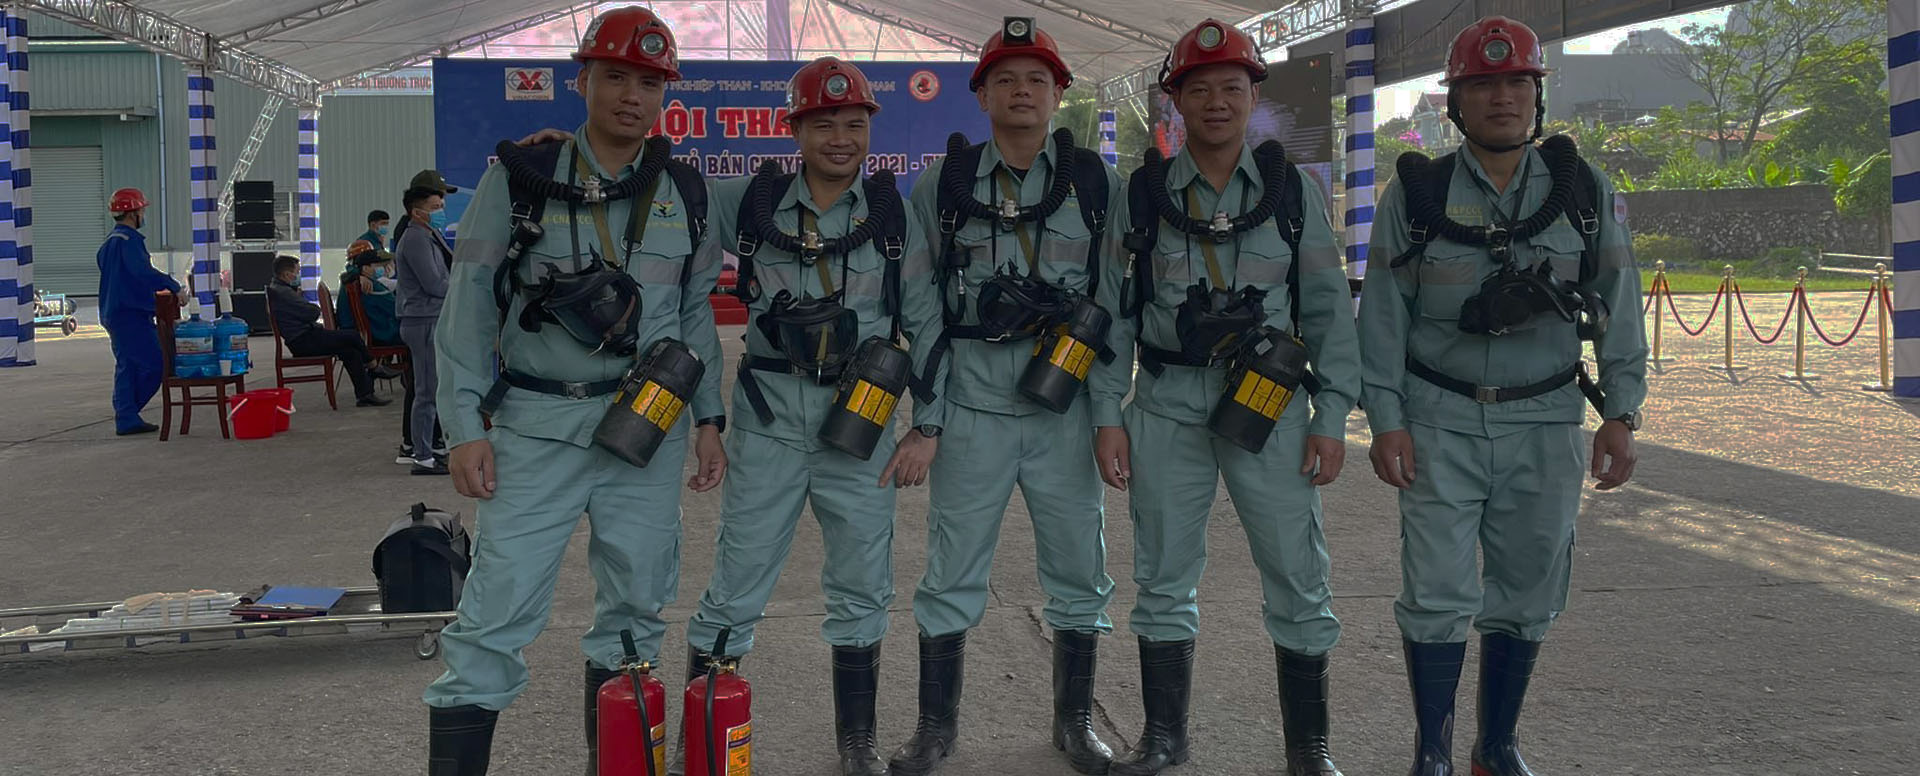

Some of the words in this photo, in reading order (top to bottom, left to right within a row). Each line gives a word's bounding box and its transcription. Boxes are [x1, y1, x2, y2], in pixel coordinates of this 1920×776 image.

[670, 79, 715, 92] NGHIỆP
[717, 80, 752, 91] THAN
[716, 107, 793, 138] THA
[705, 150, 745, 176] BÁN
[866, 153, 907, 175] 2021
